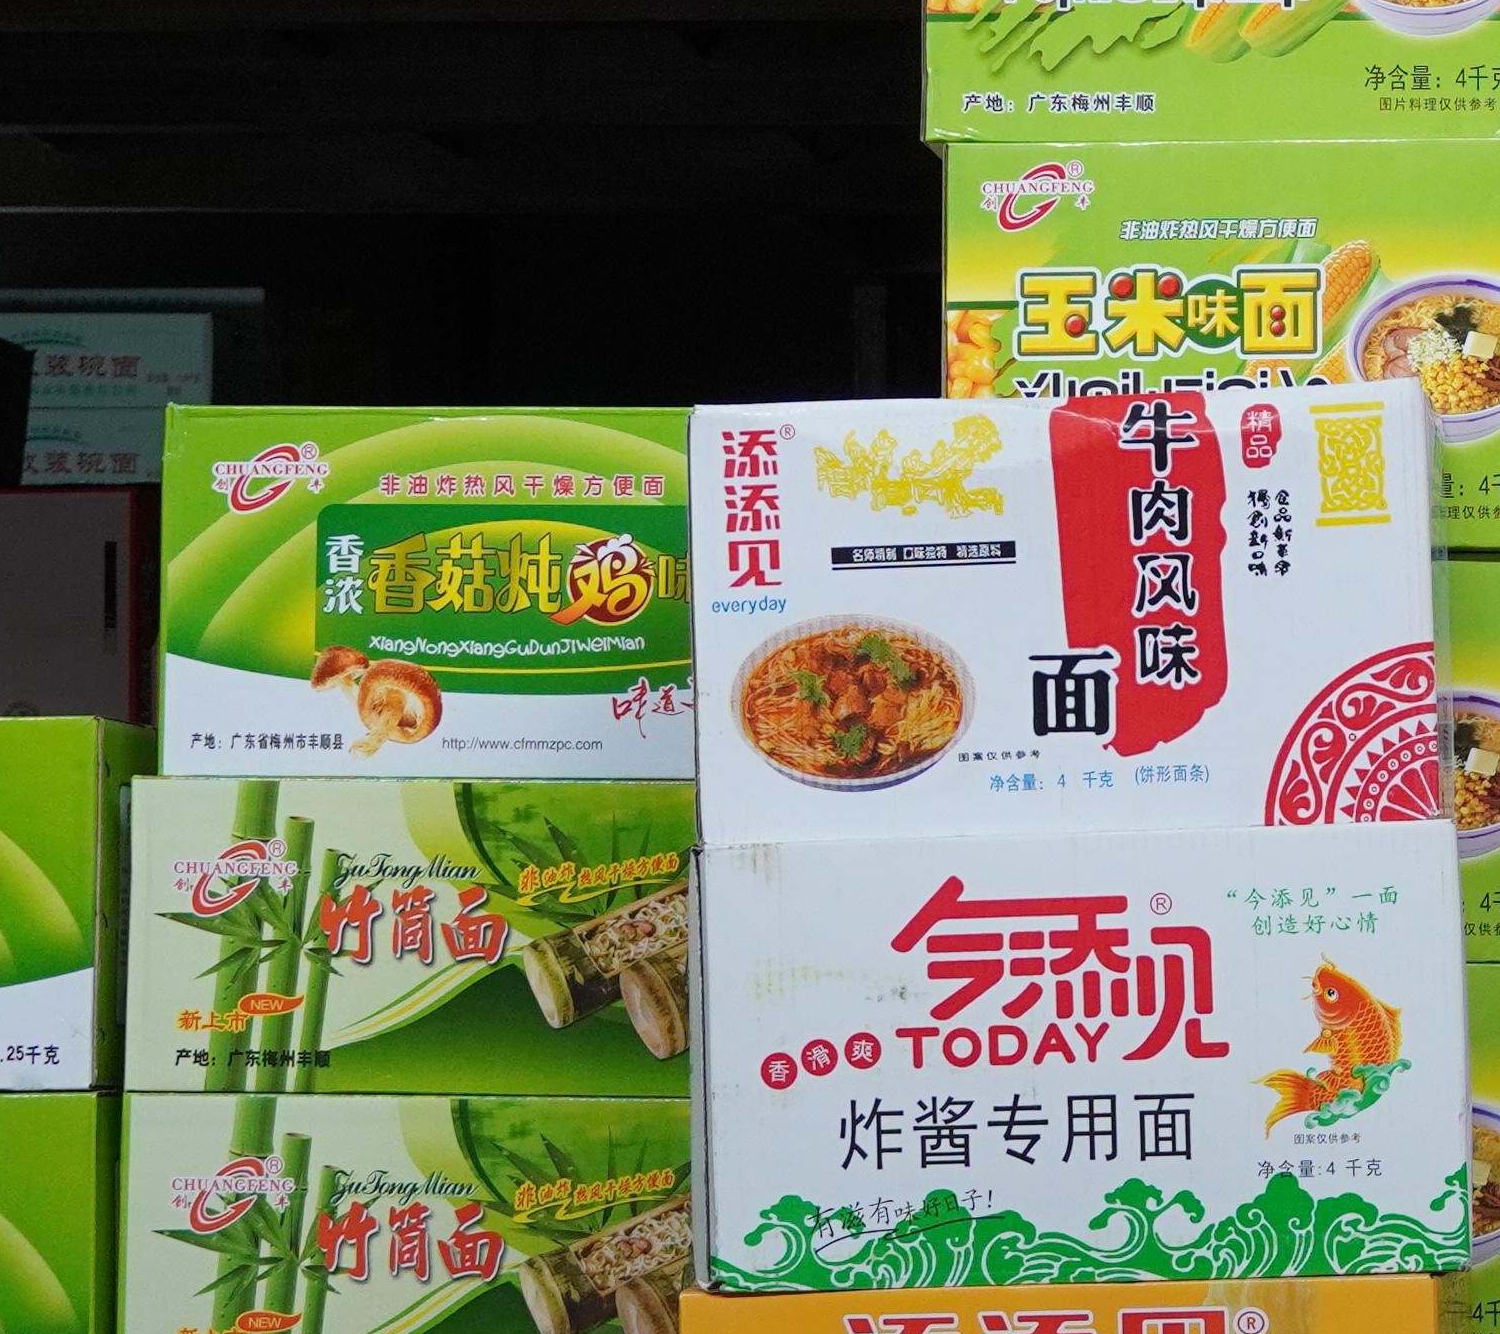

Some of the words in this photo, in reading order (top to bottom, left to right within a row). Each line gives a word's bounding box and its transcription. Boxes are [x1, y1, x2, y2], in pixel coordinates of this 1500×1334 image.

[1378, 96, 1497, 112] 图片料理仅供参考
[1016, 267, 1325, 356] 玉米味面
[1246, 410, 1274, 460] 精品
[380, 474, 664, 497] 非油炸热风干燥方便面
[722, 430, 782, 589] 添添见
[1120, 402, 1198, 686] 牛肉风味
[712, 596, 788, 615] everyday
[1030, 649, 1116, 738] 面
[958, 749, 1040, 763] 图案仅供参考
[319, 884, 507, 966] 竹筒面
[1251, 911, 1378, 936] 创造好心情
[891, 876, 1230, 1061] 今添见
[179, 1010, 246, 1031] 新上市
[250, 998, 285, 1011] NEW
[896, 1024, 1111, 1067] TODAY
[838, 1092, 1196, 1171] 炸酱专用面
[1294, 1131, 1361, 1145] 图案仅供参考
[317, 1203, 504, 1285] 竹筒面
[248, 1315, 282, 1329] NEW
